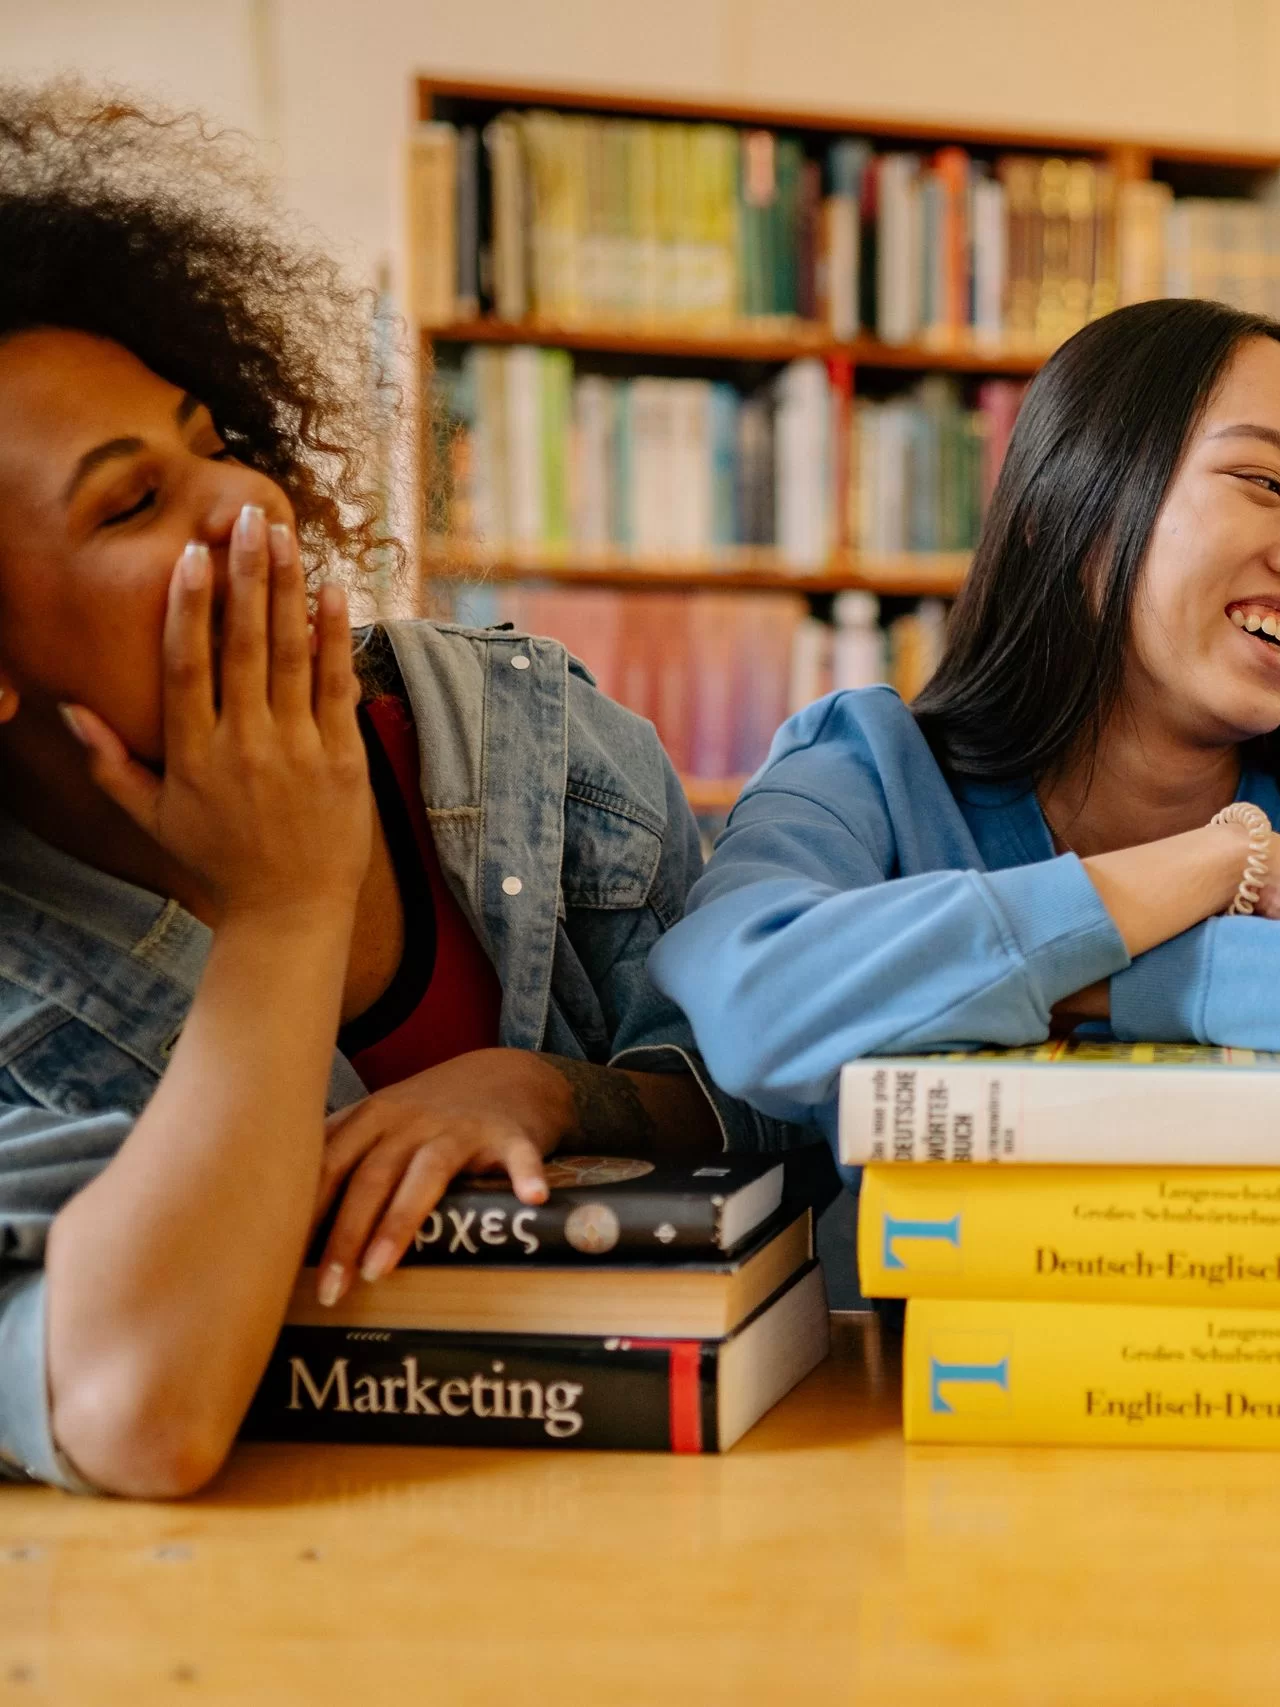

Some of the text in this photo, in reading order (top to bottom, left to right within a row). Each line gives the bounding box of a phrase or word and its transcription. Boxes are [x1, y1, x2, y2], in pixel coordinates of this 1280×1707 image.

[894, 1071, 916, 1162] DEUTSCHE
[953, 1113, 973, 1163] BUCH
[414, 1206, 541, 1255] ρχες
[286, 1357, 584, 1438] Marketing
